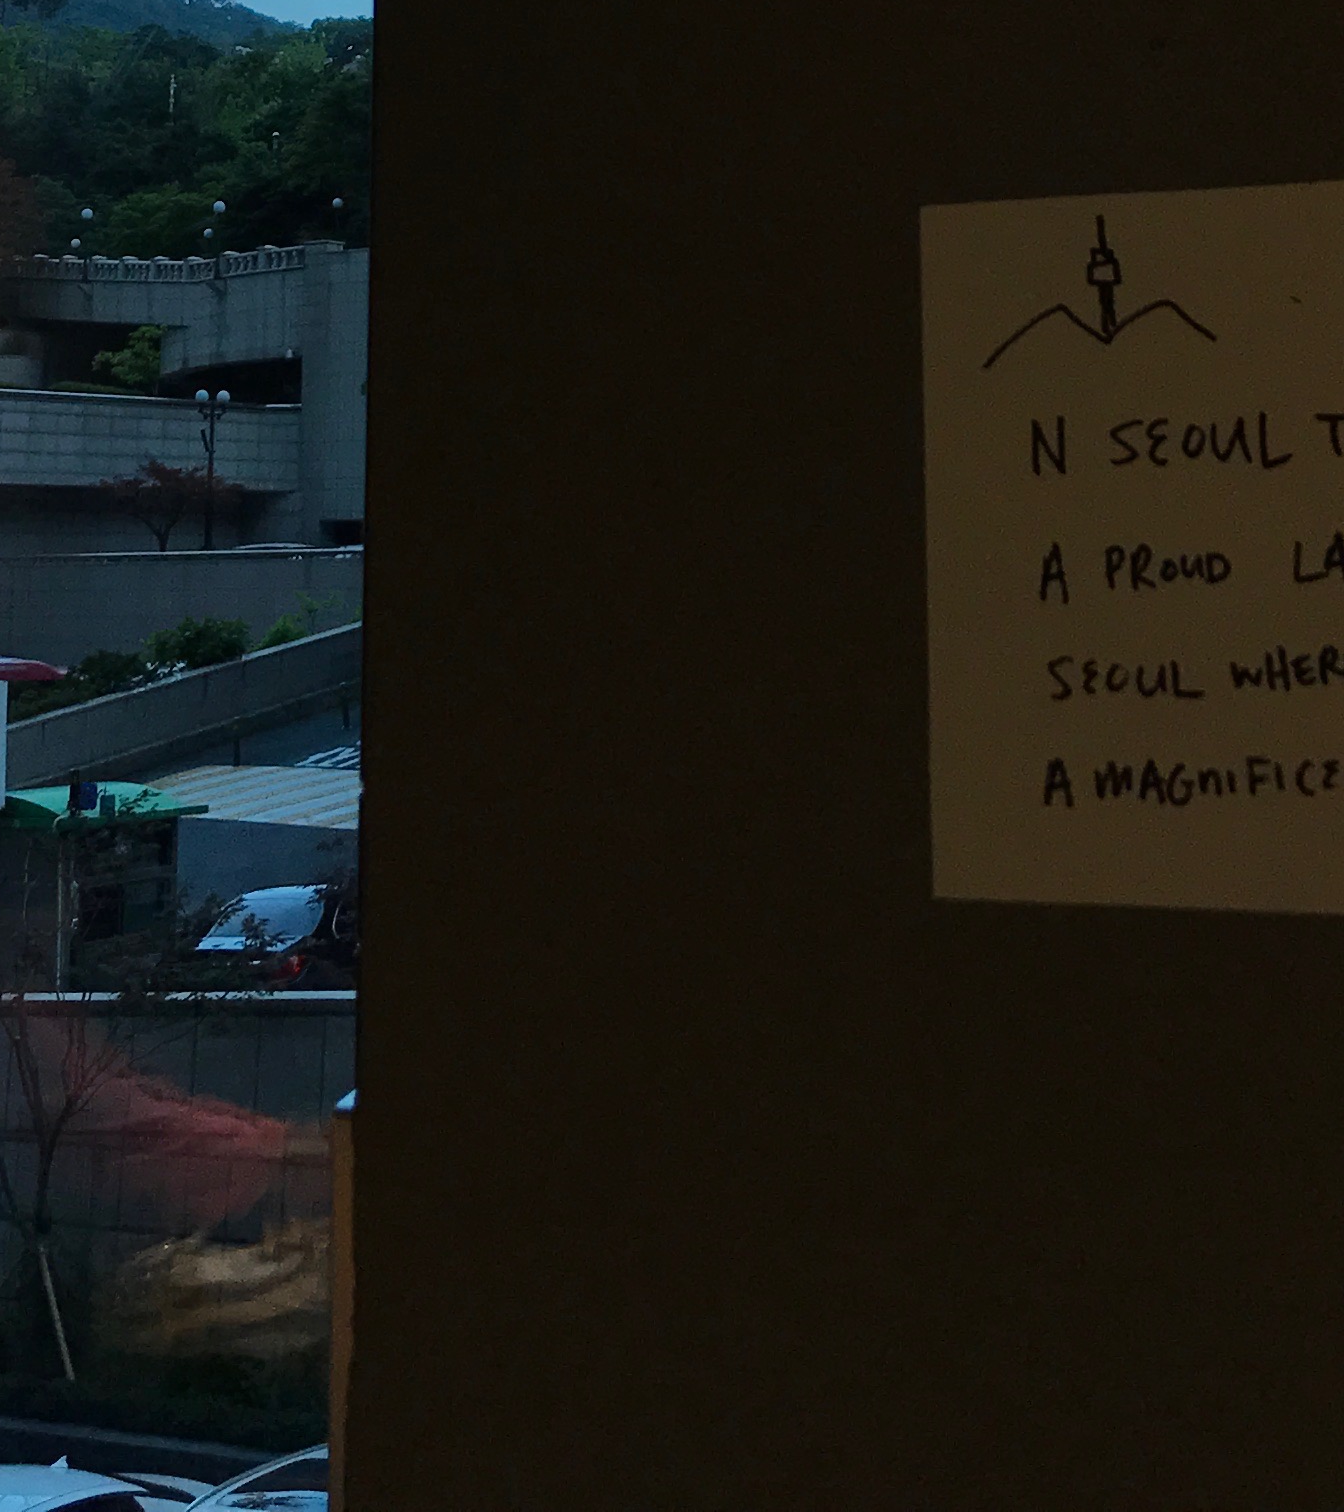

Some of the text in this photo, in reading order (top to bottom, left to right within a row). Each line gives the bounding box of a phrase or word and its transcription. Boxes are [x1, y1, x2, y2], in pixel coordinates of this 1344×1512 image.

[1030, 415, 1067, 477] N
[1108, 410, 1294, 471] SEOUL
[1038, 541, 1070, 606] A
[1103, 542, 1232, 592] PROUD
[1046, 655, 1206, 702] SEOUL
[1042, 757, 1075, 809] A
